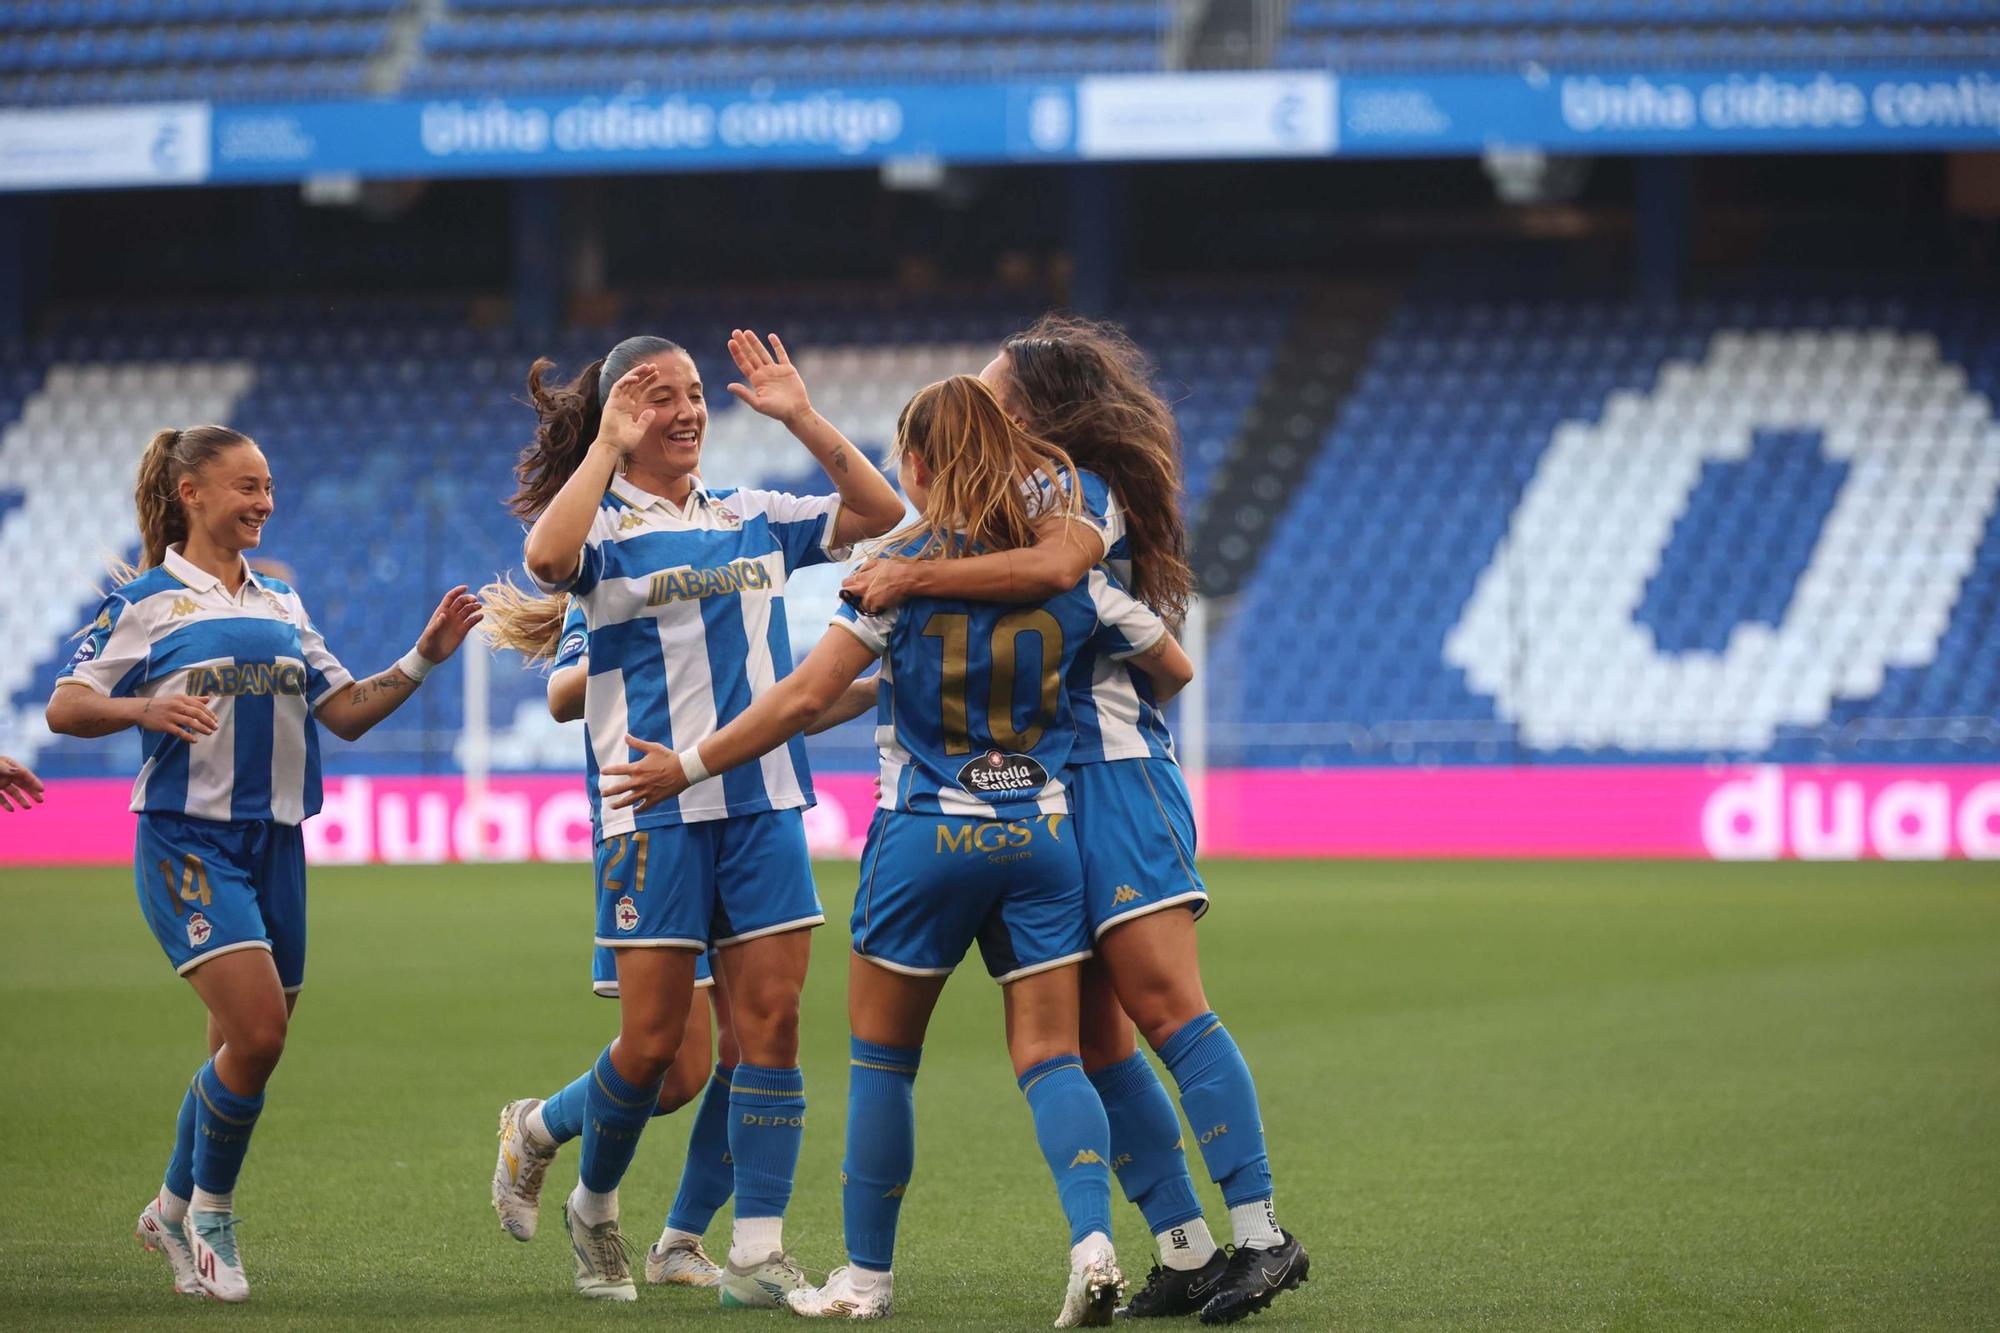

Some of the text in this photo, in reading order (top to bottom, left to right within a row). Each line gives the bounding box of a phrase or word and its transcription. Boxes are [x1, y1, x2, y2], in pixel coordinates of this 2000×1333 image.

[922, 608, 1064, 757] 10
[970, 765, 1031, 783] Estrella
[976, 779, 1033, 791] Galicia
[935, 819, 1032, 854] MGS
[604, 832, 649, 893] 21
[159, 853, 212, 916] 14
[1170, 1228, 1190, 1250] NEO
